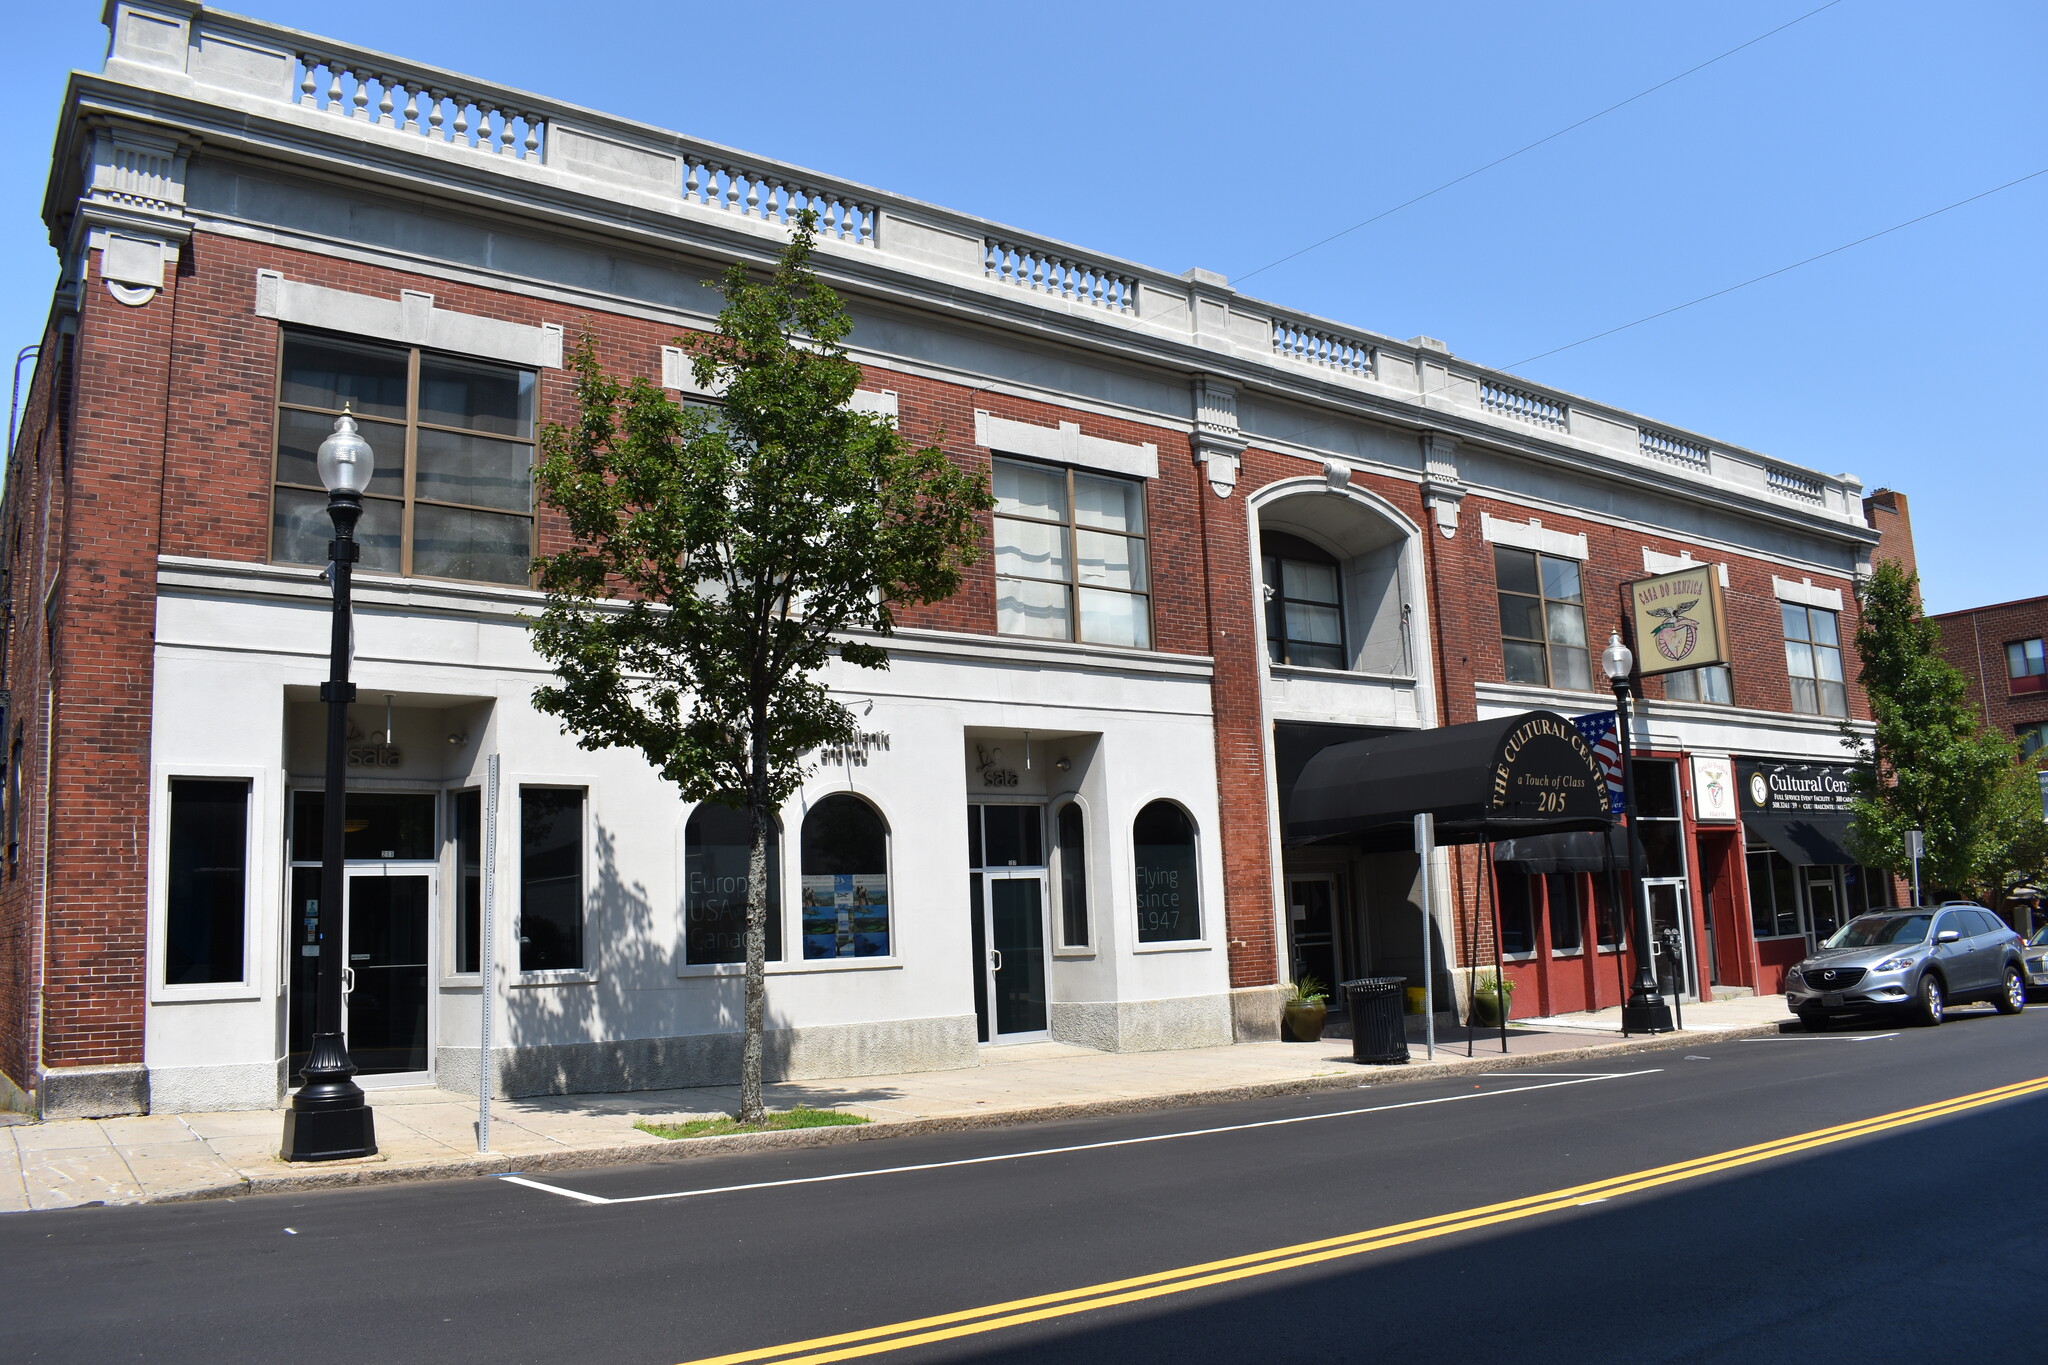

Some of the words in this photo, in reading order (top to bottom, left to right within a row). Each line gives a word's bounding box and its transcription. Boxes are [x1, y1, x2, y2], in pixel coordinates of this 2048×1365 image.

[1638, 586, 1658, 605] CASA
[1659, 582, 1670, 598] DO
[1672, 579, 1703, 596] BENFICA
[348, 743, 402, 768] sata
[1493, 763, 1510, 809] THE
[1504, 719, 1569, 763] CULTURAL
[1571, 735, 1609, 812] CENTER
[984, 769, 1019, 787] sata
[1517, 775, 1523, 785] a
[1525, 773, 1549, 787] Touch
[1551, 775, 1561, 790] of
[1562, 775, 1585, 788] Class
[1769, 774, 1823, 792] Cultural
[1825, 776, 1852, 793] Cen
[1537, 791, 1567, 812] 205
[690, 871, 748, 898] Europ
[1135, 866, 1179, 889] Flying
[690, 899, 734, 922] USA
[1137, 890, 1180, 908] since
[1139, 911, 1180, 931] 1947
[690, 927, 748, 950] Cana
